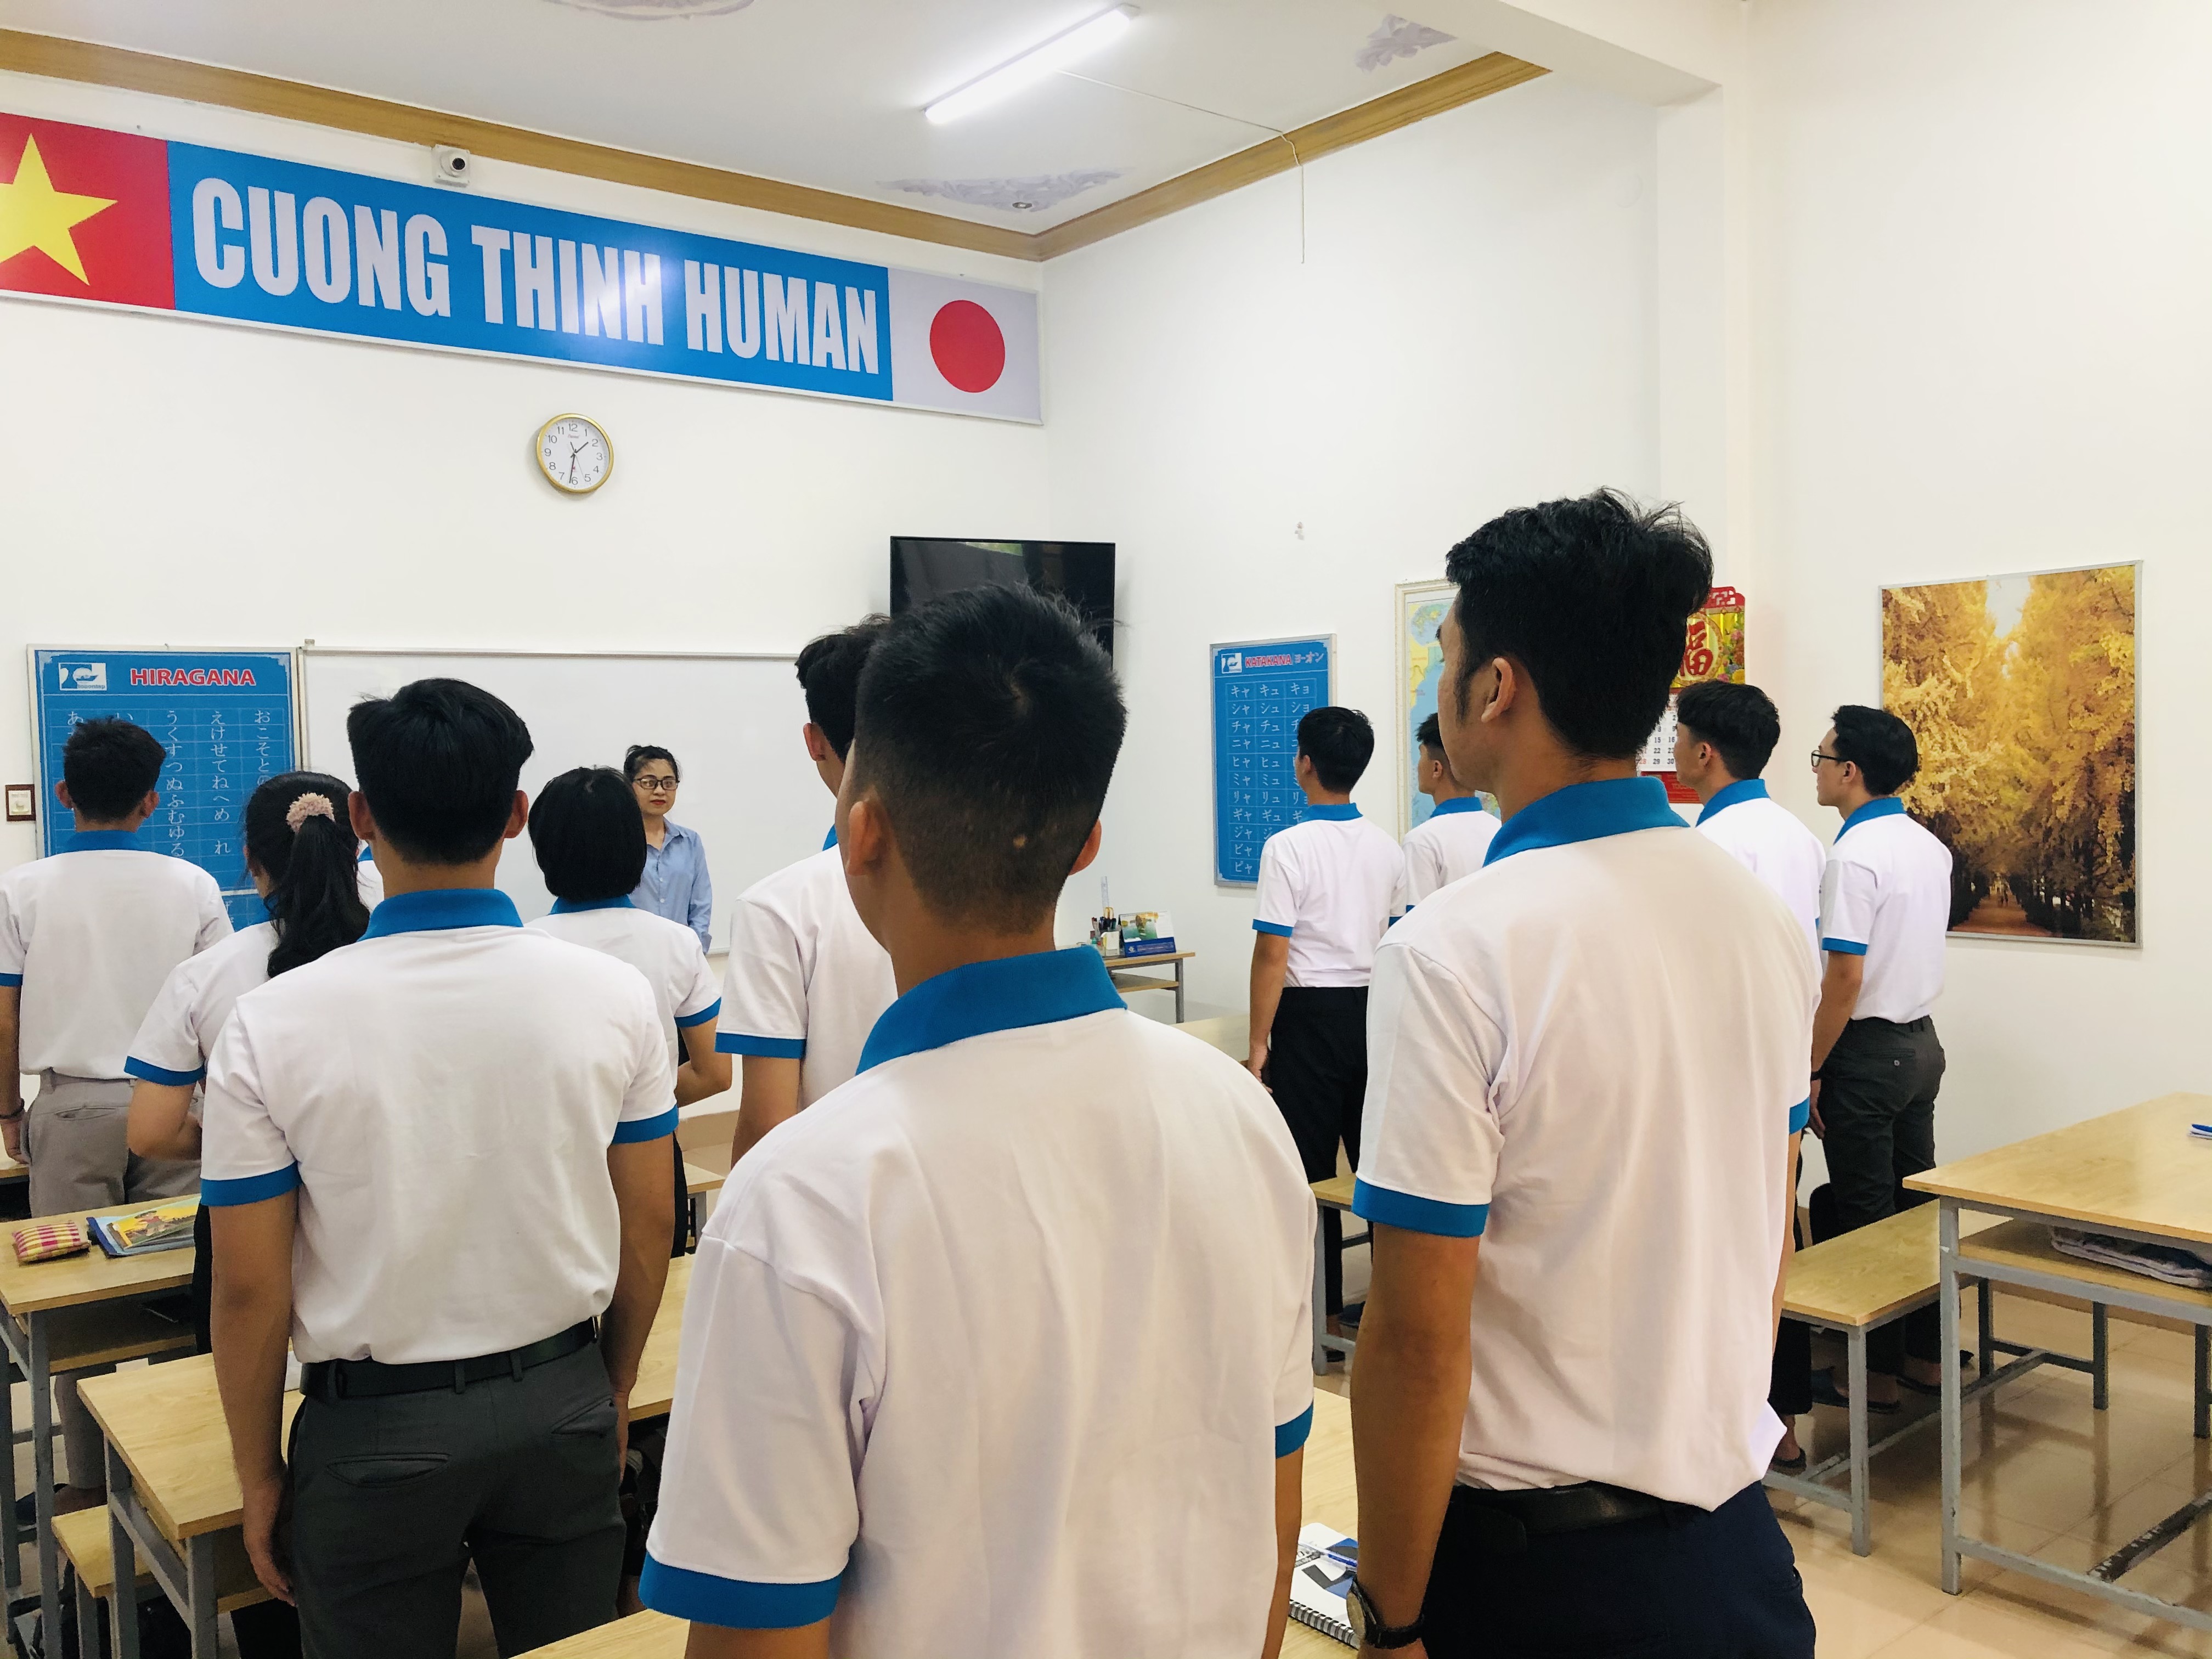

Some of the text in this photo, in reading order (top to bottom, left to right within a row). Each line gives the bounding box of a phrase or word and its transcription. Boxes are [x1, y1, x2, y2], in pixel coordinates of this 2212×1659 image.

[192, 177, 879, 375] CUONG THINH HUMAN
[557, 426, 564, 435] 11
[569, 424, 578, 432] 12
[549, 435, 557, 443] 10
[544, 448, 551, 456] 9
[549, 462, 556, 470] 8
[571, 477, 578, 485] 6
[1245, 654, 1293, 668] KATAKANA
[131, 668, 256, 686] HIRAGANA
